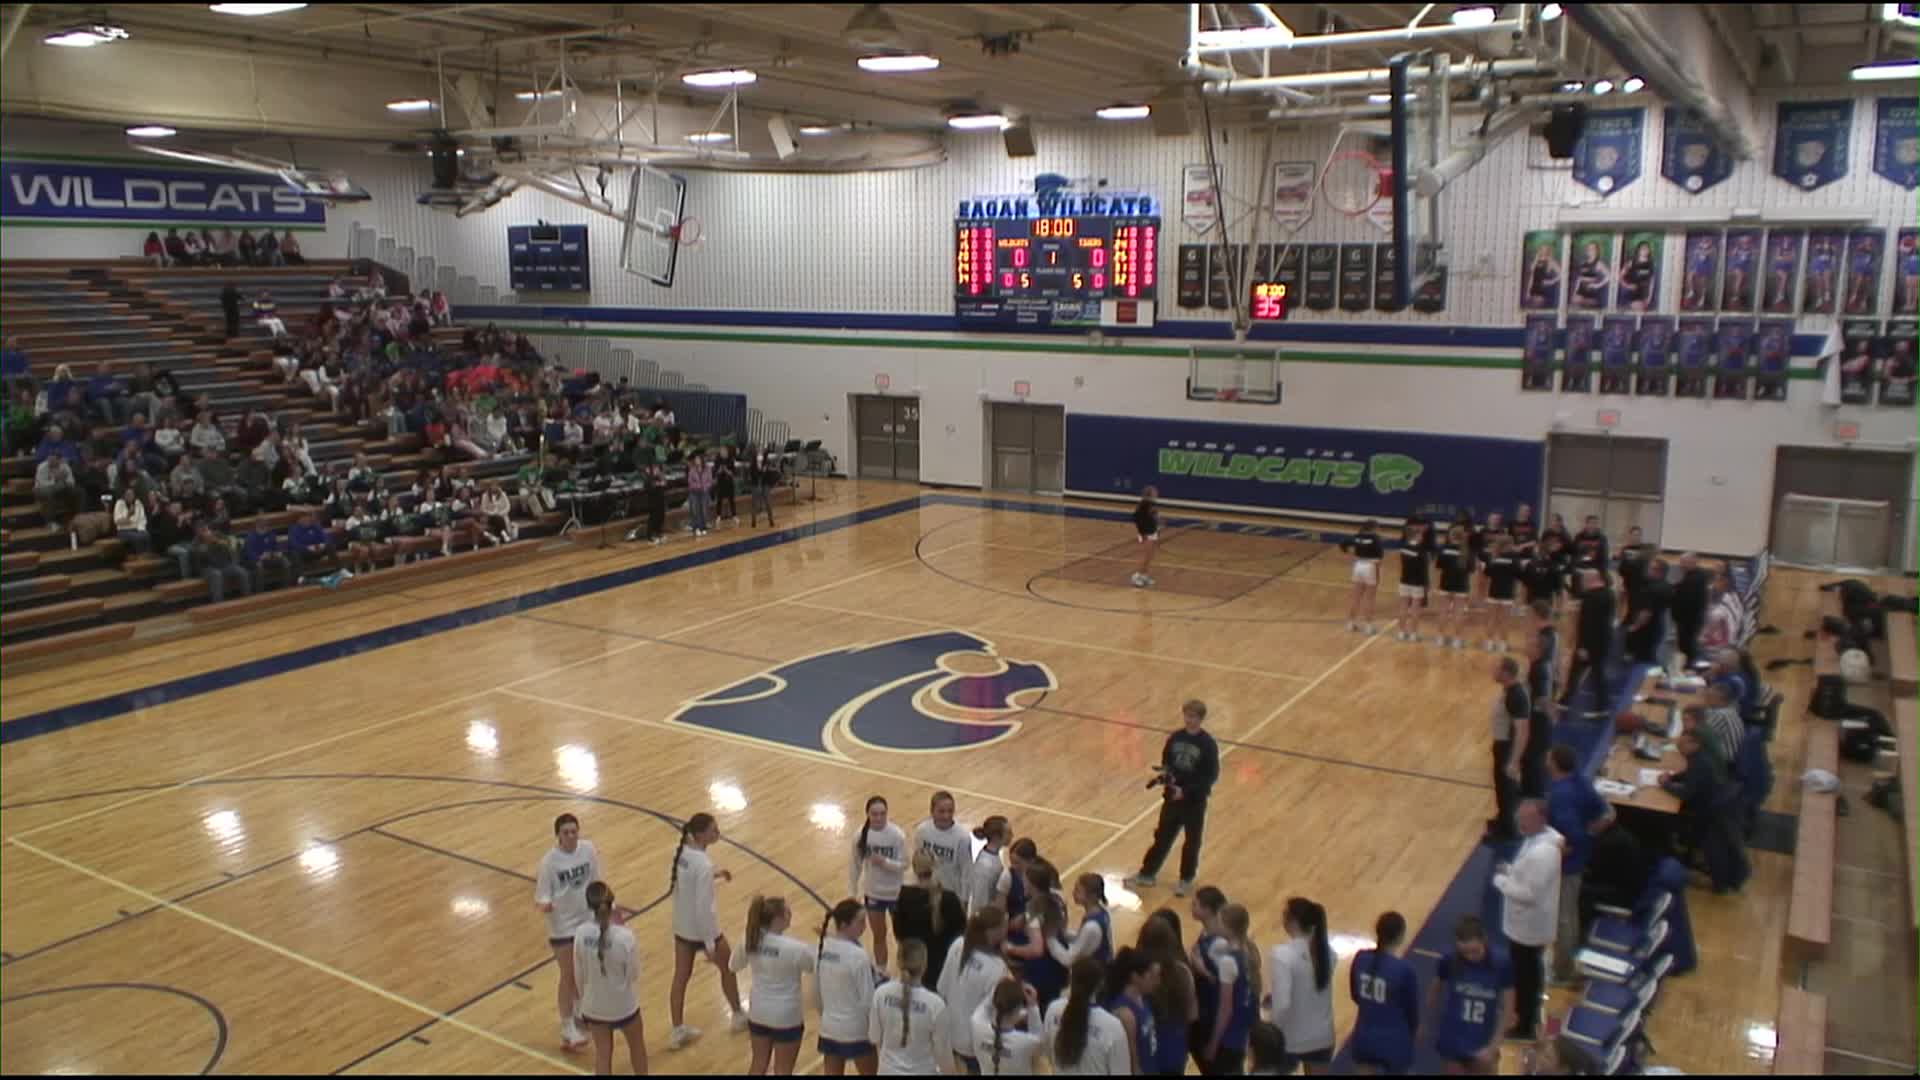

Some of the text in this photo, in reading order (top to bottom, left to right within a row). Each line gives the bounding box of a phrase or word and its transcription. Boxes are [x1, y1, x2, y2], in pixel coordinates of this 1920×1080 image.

[11, 174, 306, 213] WILDCATS
[959, 196, 1152, 217] EAGAN WILDCATS
[1035, 219, 1073, 236] 18:00
[1015, 248, 1024, 266] 0
[1093, 248, 1104, 267] 0
[1004, 273, 1030, 288] 0 5
[1073, 273, 1104, 289] 5 0
[1257, 296, 1280, 317] 35
[904, 406, 918, 420] 35
[1159, 448, 1365, 488] WILDCATS
[1360, 973, 1387, 1004] 20
[1462, 999, 1486, 1024] 12
